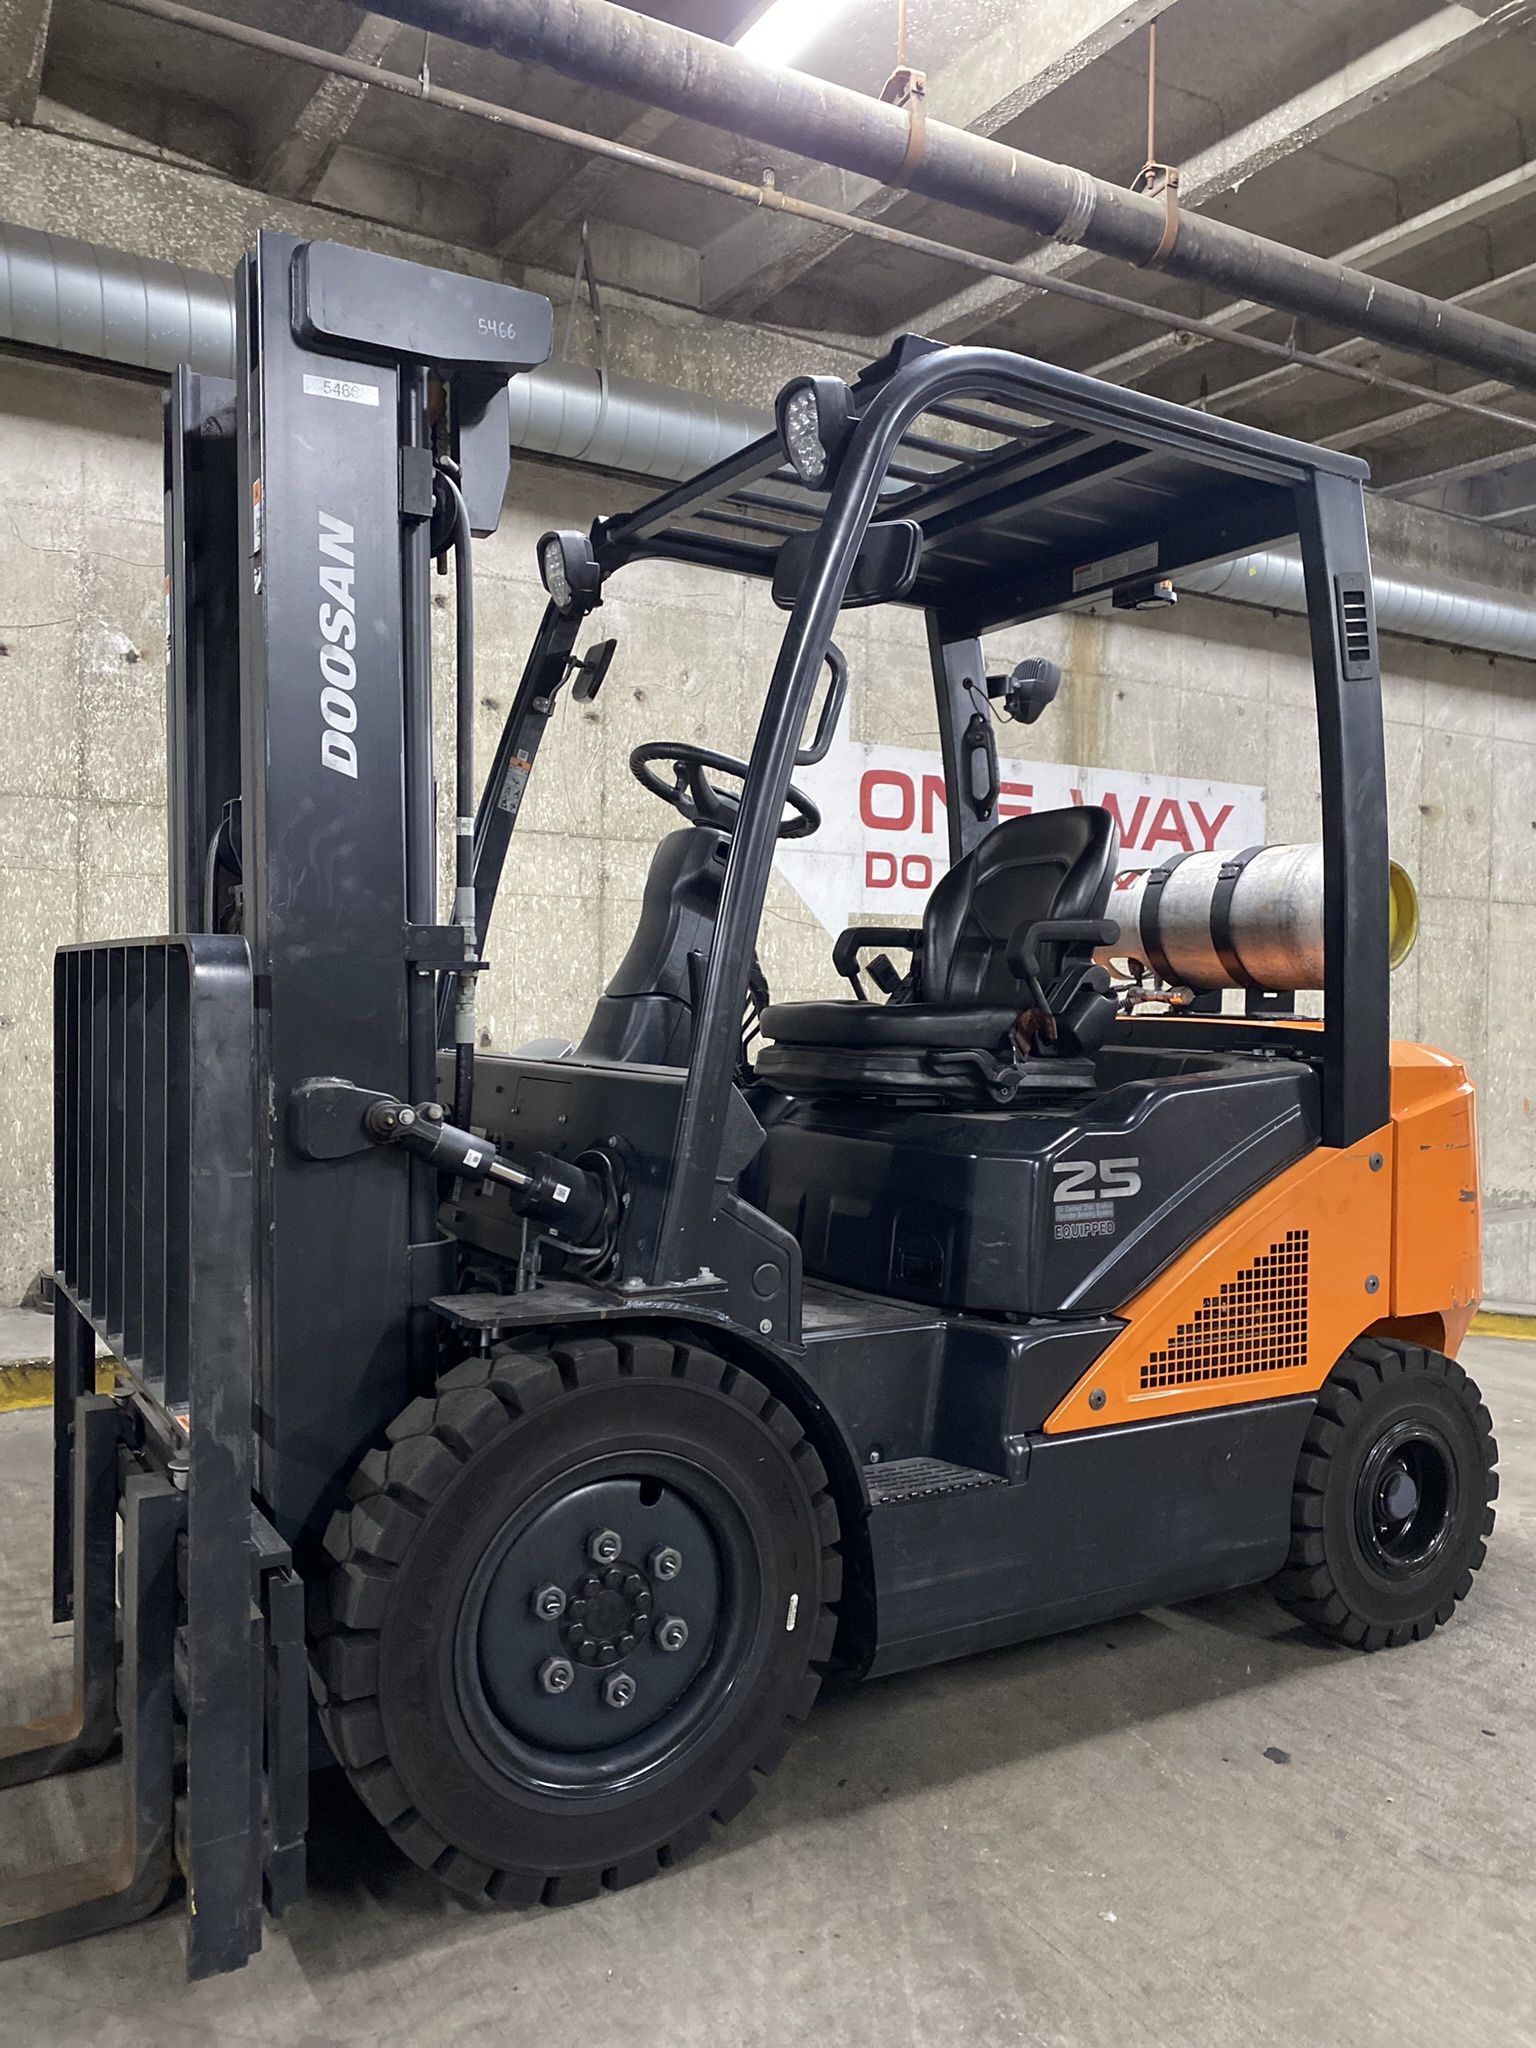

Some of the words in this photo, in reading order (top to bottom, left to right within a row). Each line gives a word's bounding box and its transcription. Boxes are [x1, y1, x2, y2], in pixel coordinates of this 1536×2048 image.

[478, 317, 517, 340] 5466
[318, 510, 358, 779] DOOSAN
[1069, 788, 1236, 852] WAY
[865, 851, 933, 890] DO
[1053, 1157, 1142, 1202] 25
[1054, 1220, 1116, 1240] EQUIPPED
